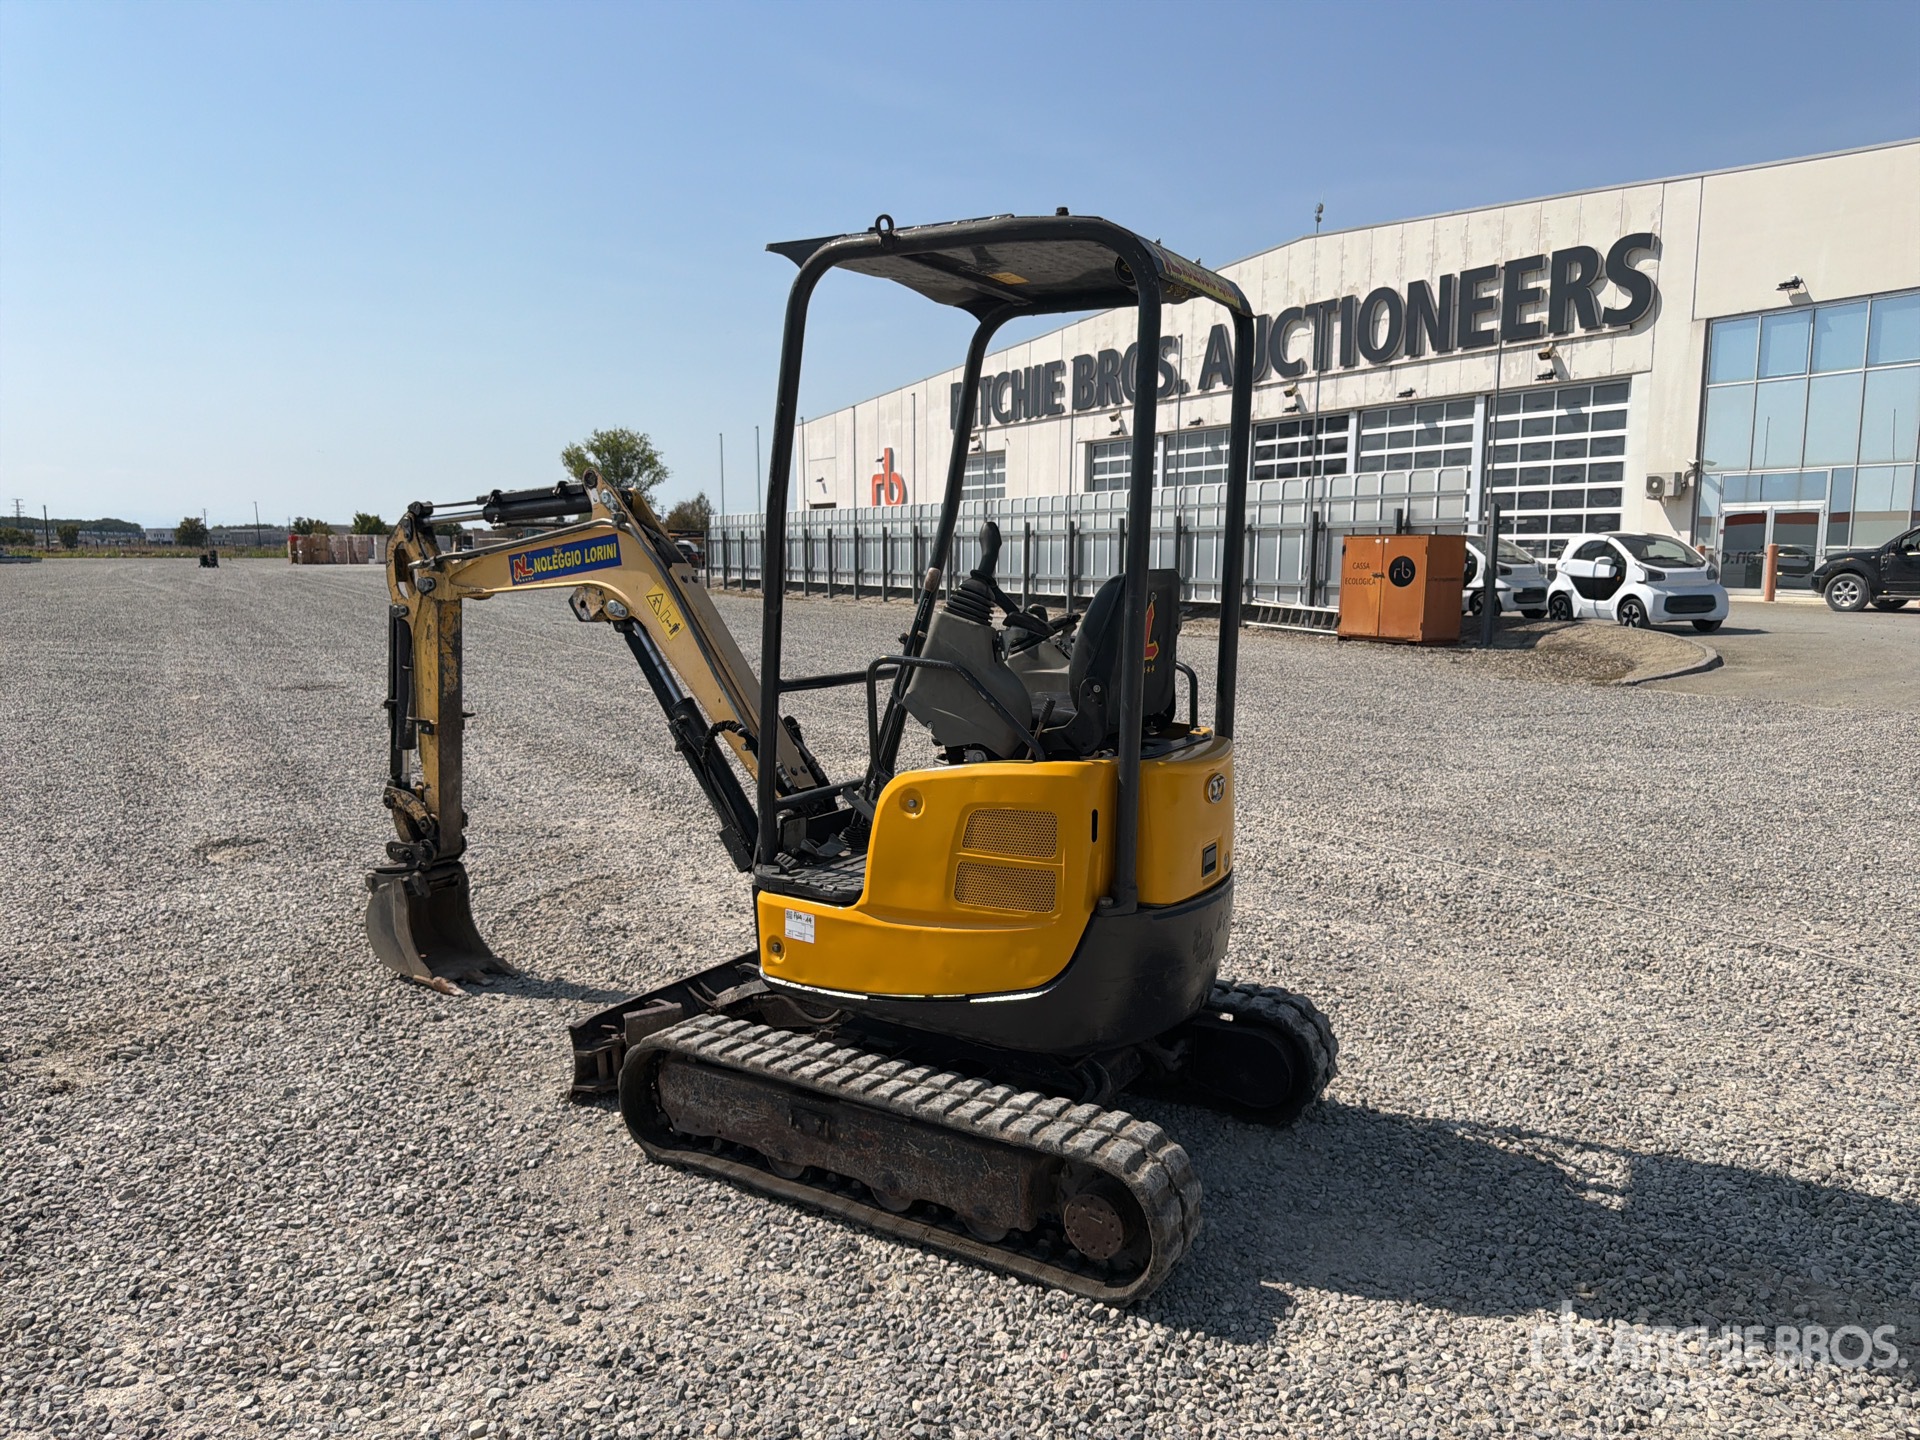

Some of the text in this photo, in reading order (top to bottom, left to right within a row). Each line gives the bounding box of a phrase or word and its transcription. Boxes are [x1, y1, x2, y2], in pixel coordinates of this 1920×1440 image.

[950, 359, 1066, 430] TCHIE
[1197, 232, 1657, 390] AUCTIONEERS
[534, 549, 582, 573] NOLEGGIO
[584, 543, 617, 564] LORINI
[1352, 562, 1371, 570] CASSA
[1393, 561, 1412, 579] rb
